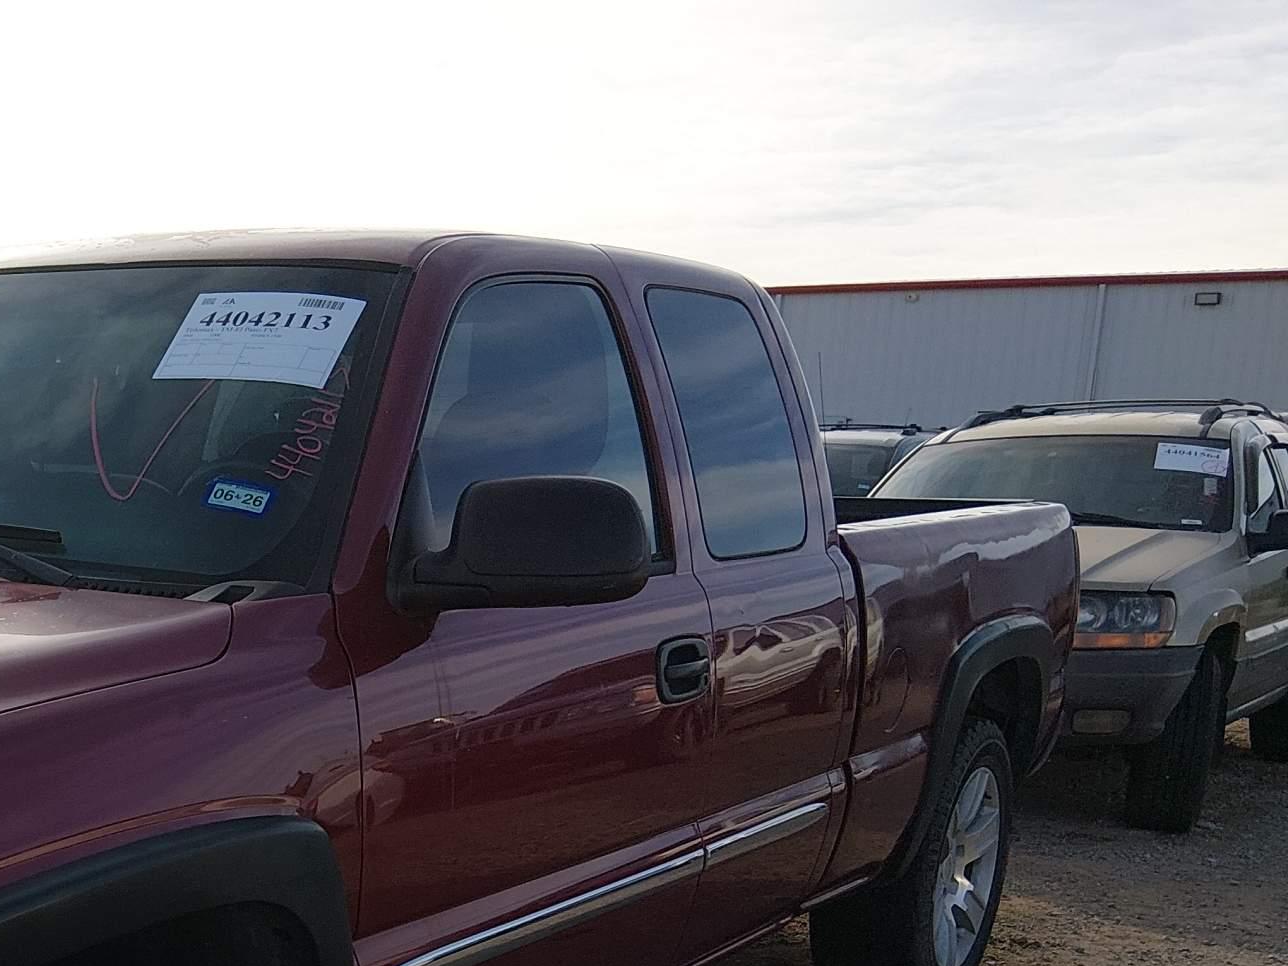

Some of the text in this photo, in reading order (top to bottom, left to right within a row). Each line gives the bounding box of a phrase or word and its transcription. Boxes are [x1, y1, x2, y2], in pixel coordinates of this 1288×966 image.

[199, 310, 332, 331] 44042113
[213, 488, 235, 502] 06
[241, 493, 264, 508] 26
